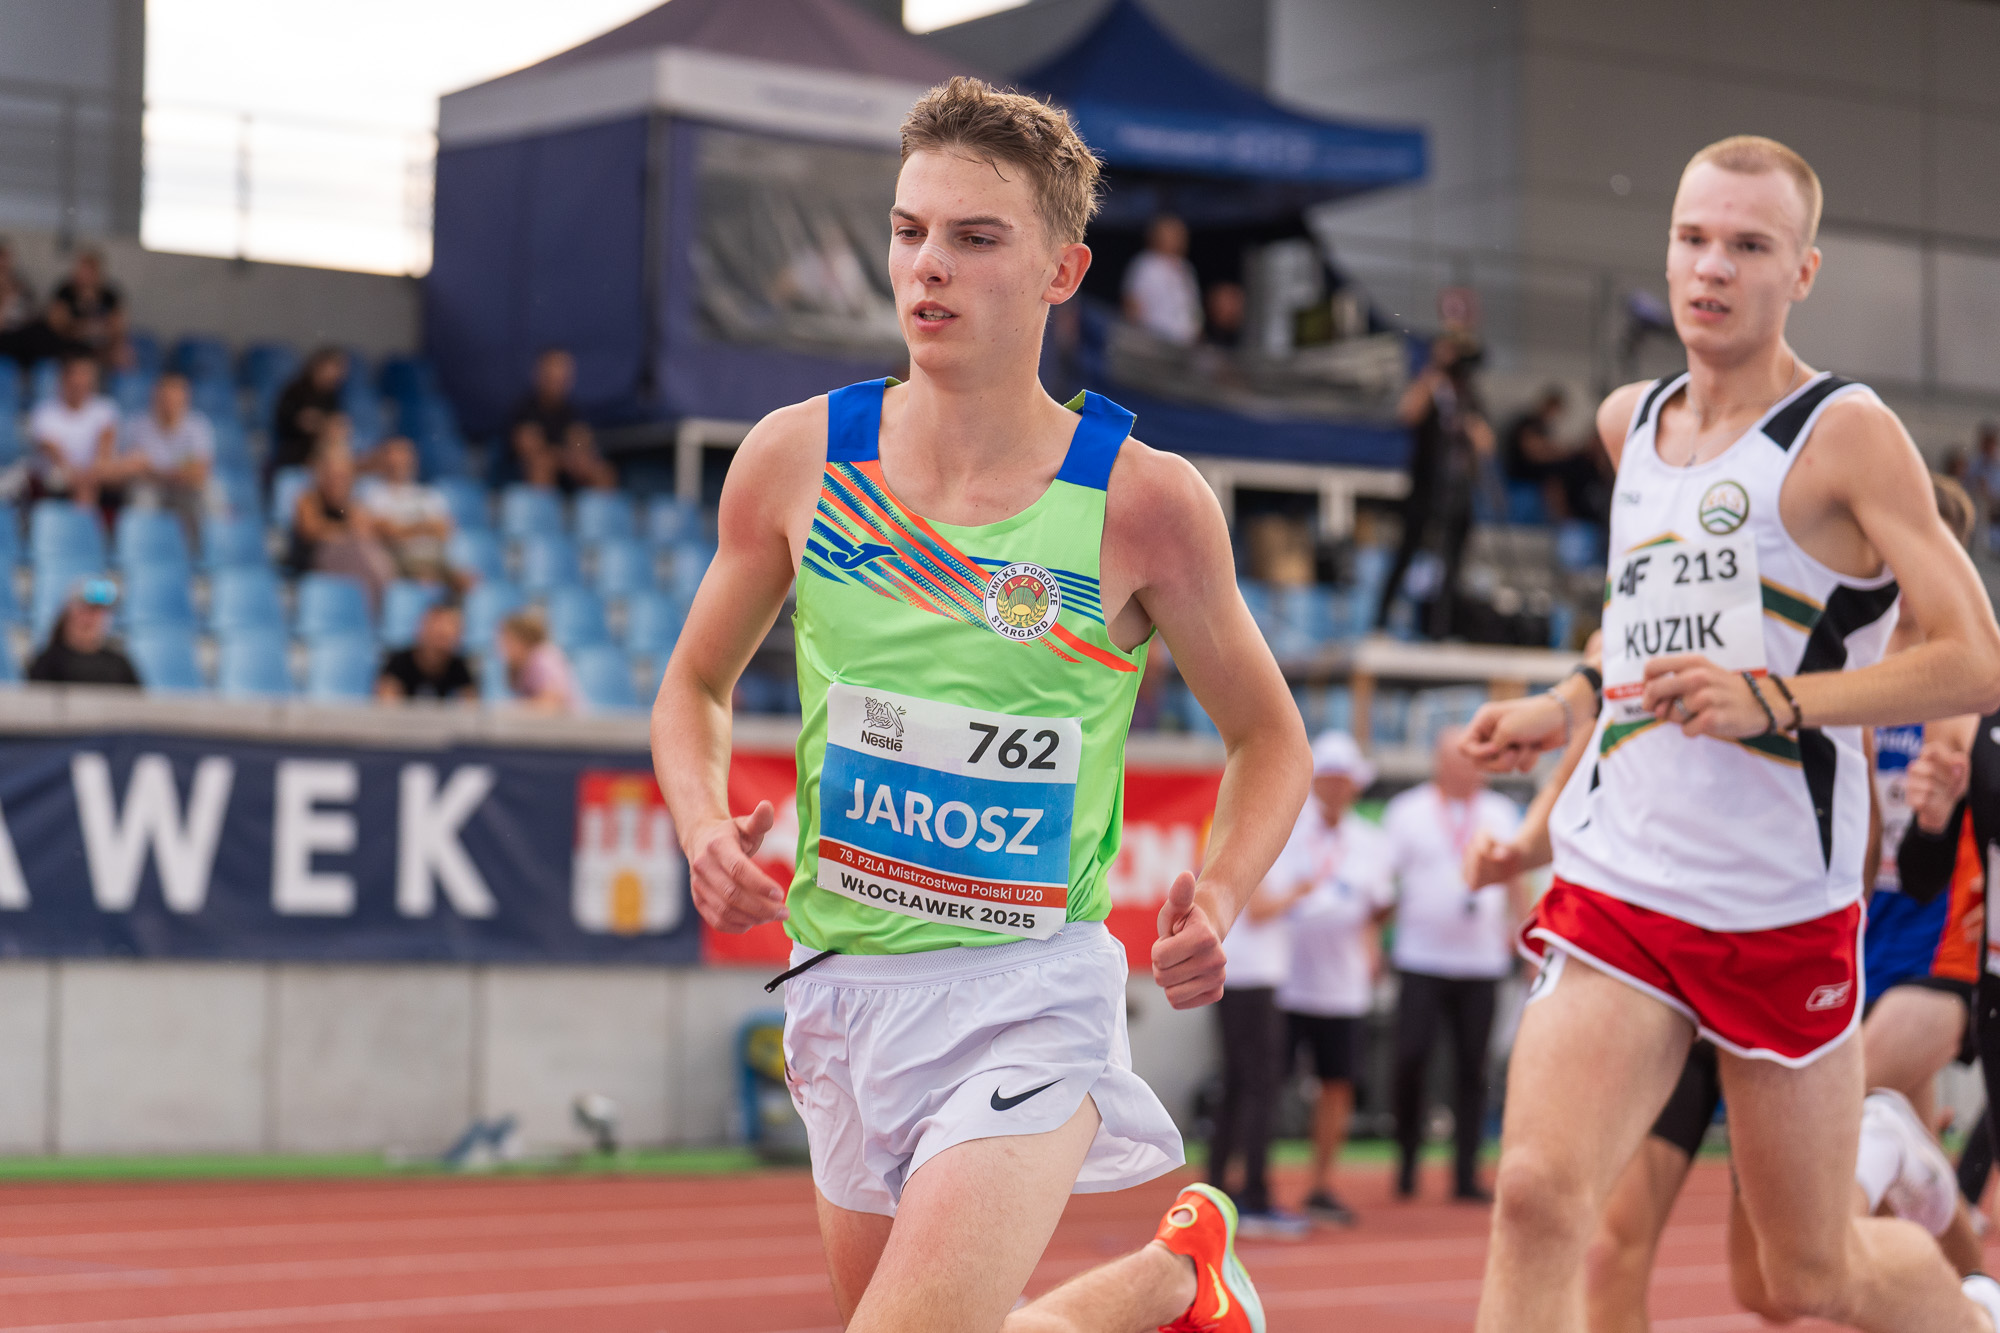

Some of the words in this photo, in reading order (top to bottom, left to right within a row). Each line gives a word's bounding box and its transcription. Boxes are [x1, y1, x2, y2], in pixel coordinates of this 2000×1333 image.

[988, 567, 1017, 599] WMLKS
[1023, 566, 1058, 606] POMORZE
[1007, 577, 1041, 592] LZS
[1672, 548, 1738, 585] 213
[991, 615, 1049, 637] STARGARD
[1625, 611, 1725, 659] KUZIK
[860, 730, 903, 752] Nestlé
[967, 721, 1060, 770] 762
[0, 752, 498, 918] WEK
[845, 778, 1044, 856] JAROSZ
[839, 848, 855, 864] 79.
[857, 855, 886, 875] PZLA
[888, 865, 967, 893] Mistrzostwa
[971, 883, 1012, 901] Polski
[1016, 889, 1043, 902] U20
[840, 871, 976, 920] WŁOCŁAWEK
[980, 907, 1036, 929] 2025
